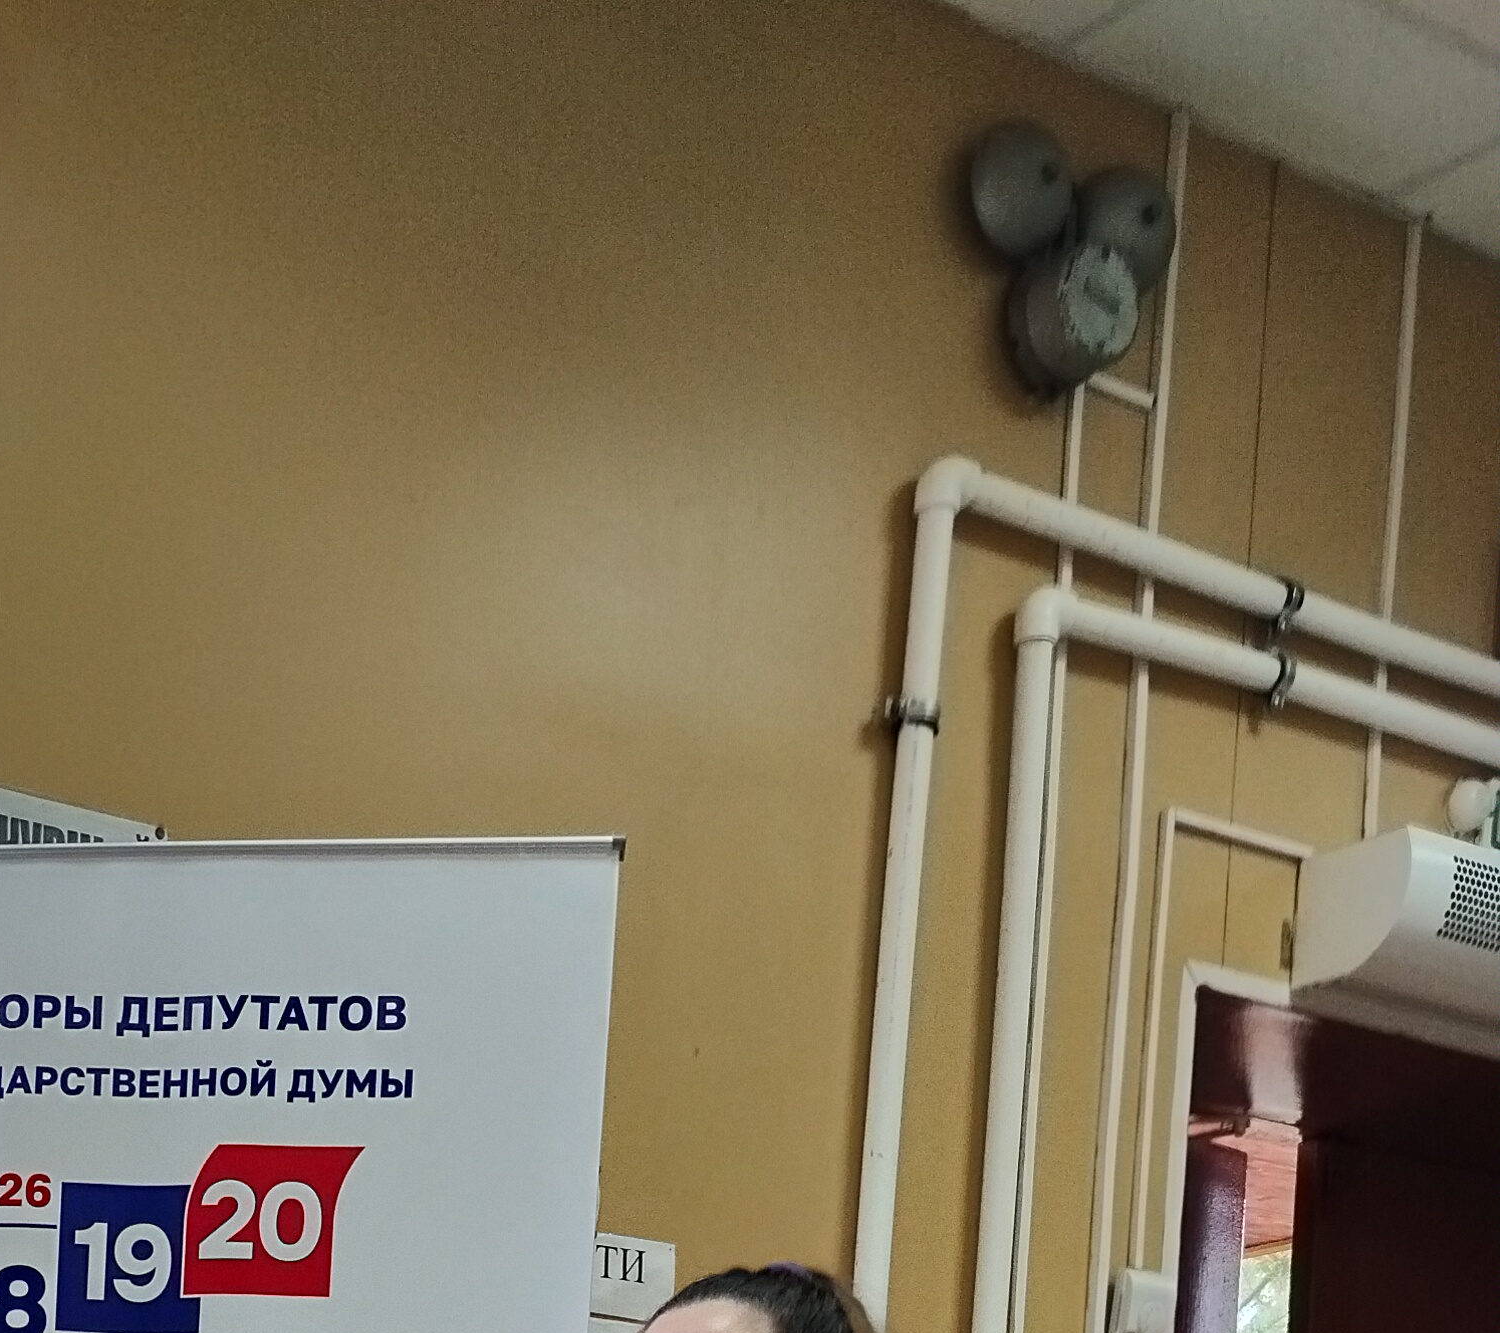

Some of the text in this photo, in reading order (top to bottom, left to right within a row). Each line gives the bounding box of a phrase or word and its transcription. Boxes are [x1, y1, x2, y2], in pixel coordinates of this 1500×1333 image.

[115, 993, 407, 1038] ДЕПУТАТОВ
[286, 1068, 414, 1104] ДУМЫ
[74, 1222, 172, 1303] 19
[198, 1178, 322, 1263] 20
